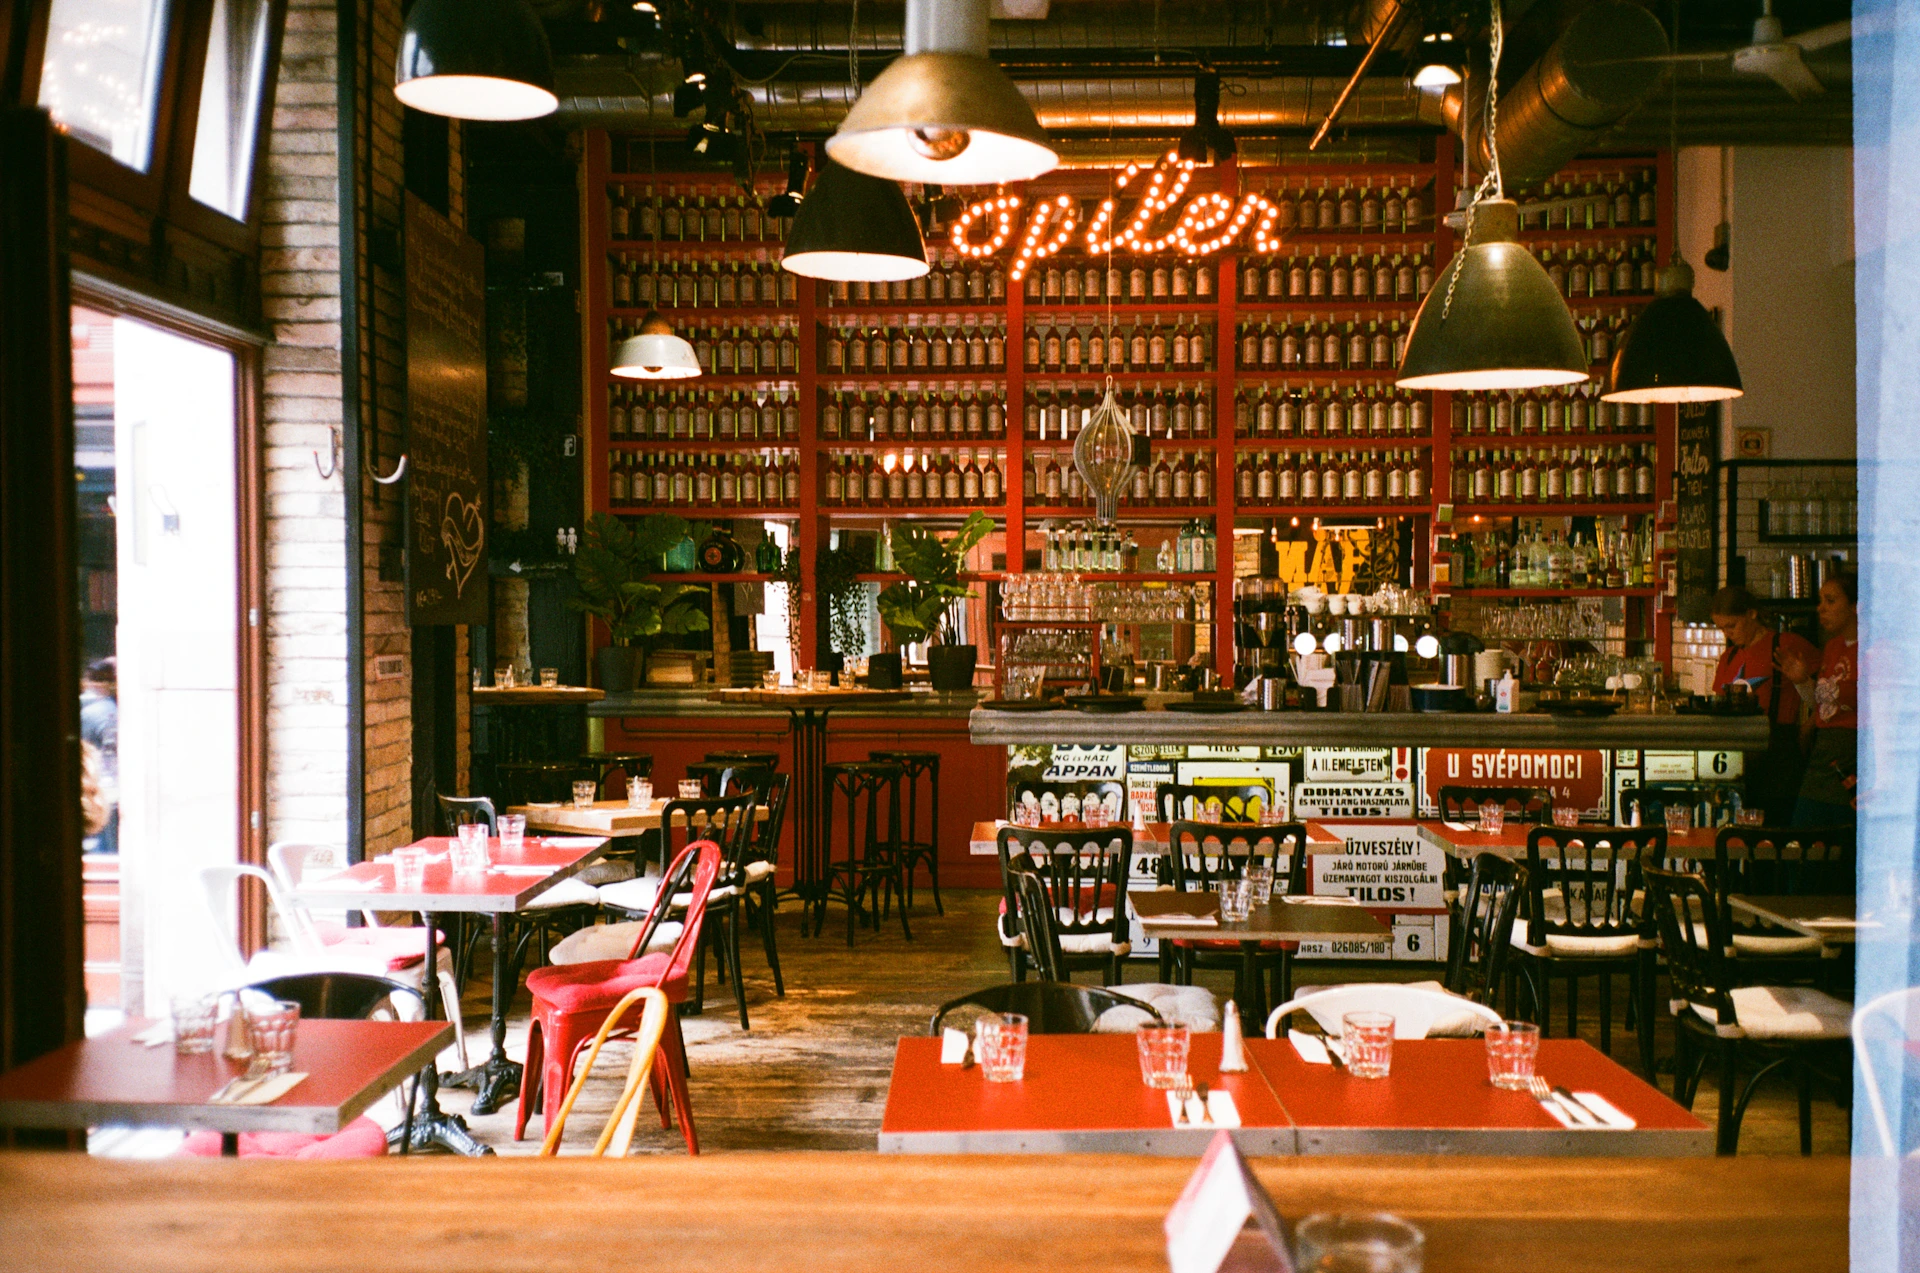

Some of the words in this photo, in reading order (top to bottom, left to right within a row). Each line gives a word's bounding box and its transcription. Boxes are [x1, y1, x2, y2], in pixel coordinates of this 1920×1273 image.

[1312, 759, 1318, 771] A
[1447, 753, 1460, 778] U
[1472, 749, 1582, 779] SVÉPOMOCI
[1713, 752, 1727, 774] 6
[1562, 786, 1571, 799] 4
[1384, 872, 1438, 884] KISZOLGÁLNI
[1407, 934, 1420, 952] 6
